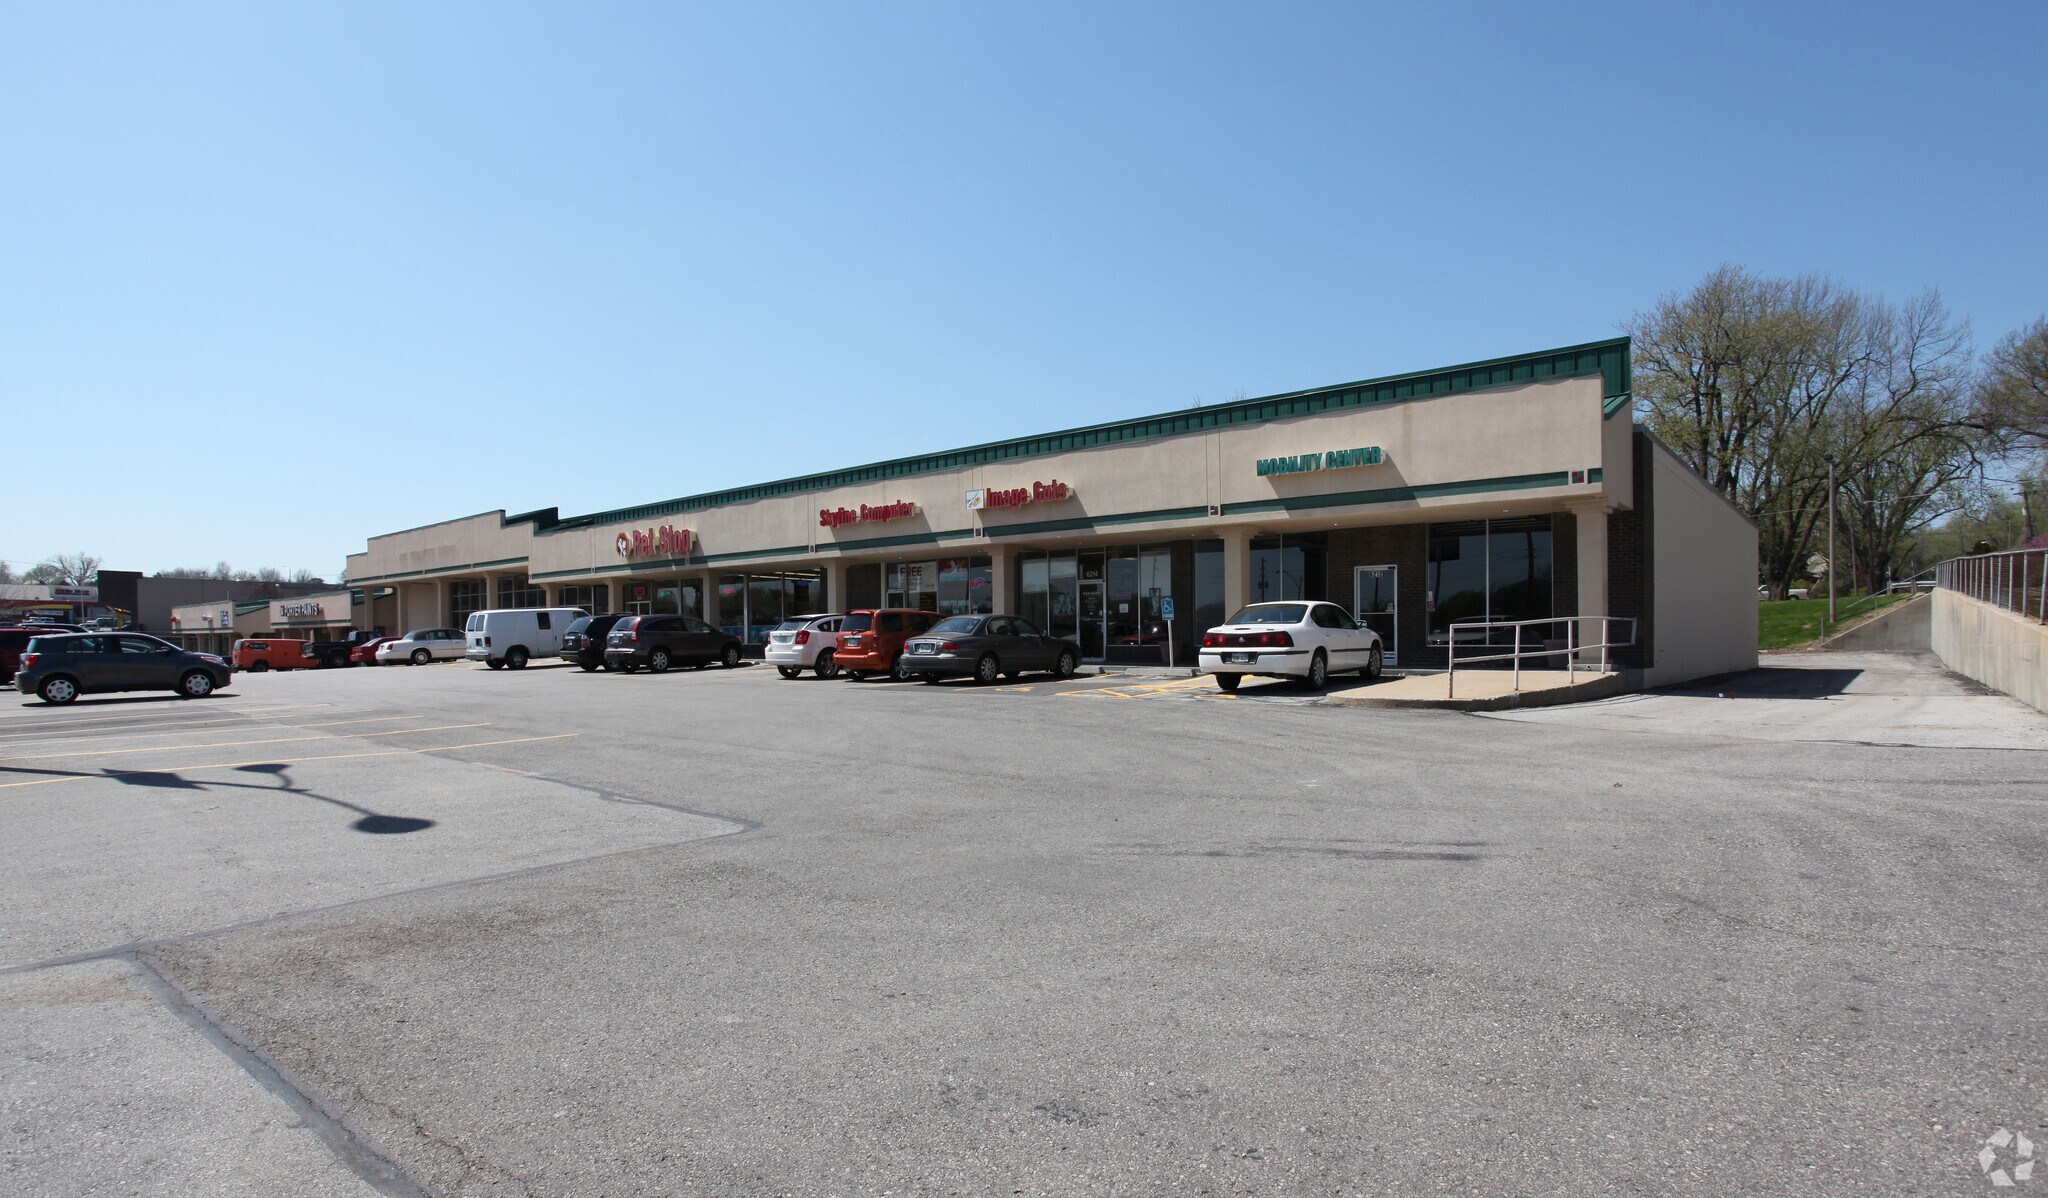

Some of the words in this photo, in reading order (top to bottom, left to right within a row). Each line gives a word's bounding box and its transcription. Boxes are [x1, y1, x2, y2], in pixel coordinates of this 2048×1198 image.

[1256, 452, 1324, 477] MOBILITY
[1325, 446, 1382, 469] CENTER
[986, 487, 1028, 507] Image
[1032, 479, 1068, 503] Cuts
[819, 508, 857, 529] Skyline
[860, 500, 914, 522] Computer
[632, 528, 655, 557] Pet
[659, 525, 692, 556] Stop
[900, 566, 923, 577] FREE
[284, 604, 302, 617] PORTER
[302, 603, 319, 616] PAINTS
